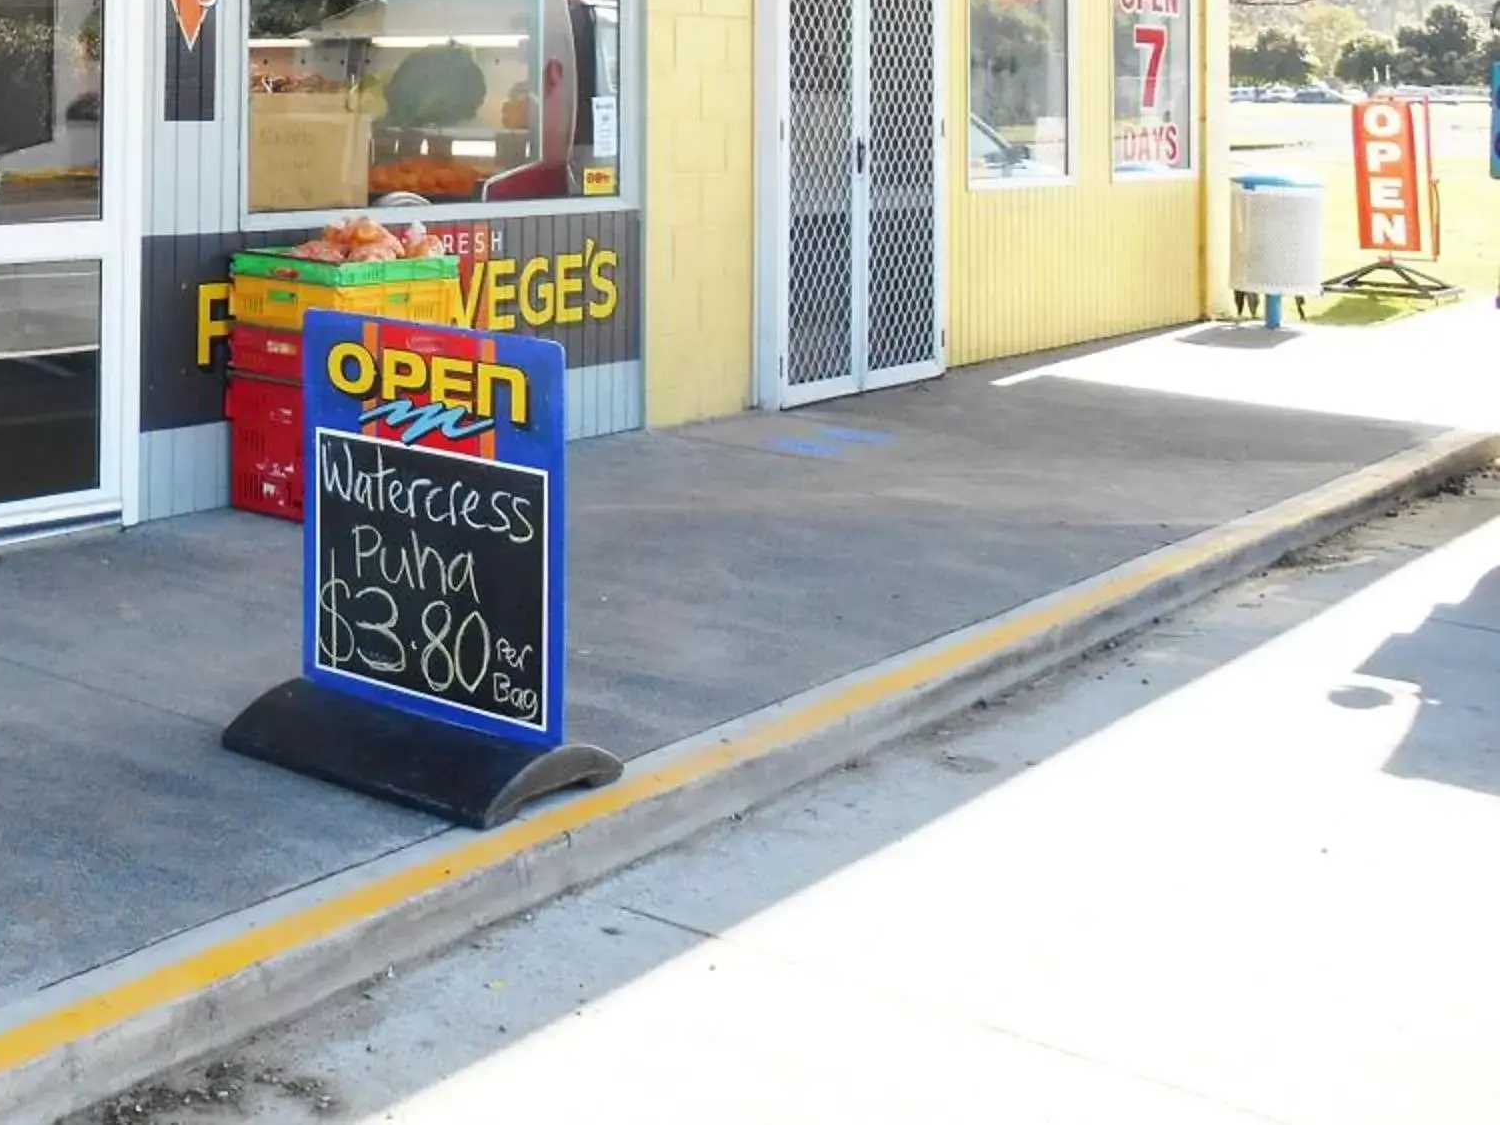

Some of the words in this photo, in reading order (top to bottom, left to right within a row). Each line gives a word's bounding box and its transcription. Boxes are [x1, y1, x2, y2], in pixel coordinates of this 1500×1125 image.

[1134, 26, 1167, 108] 7
[1122, 126, 1178, 161] DAYS
[1362, 105, 1408, 247] OPEN
[443, 230, 504, 253] RESH
[321, 440, 534, 543] Watercress
[352, 524, 481, 604] Puha
[320, 546, 492, 693] $3.80
[492, 671, 539, 721] Bag
